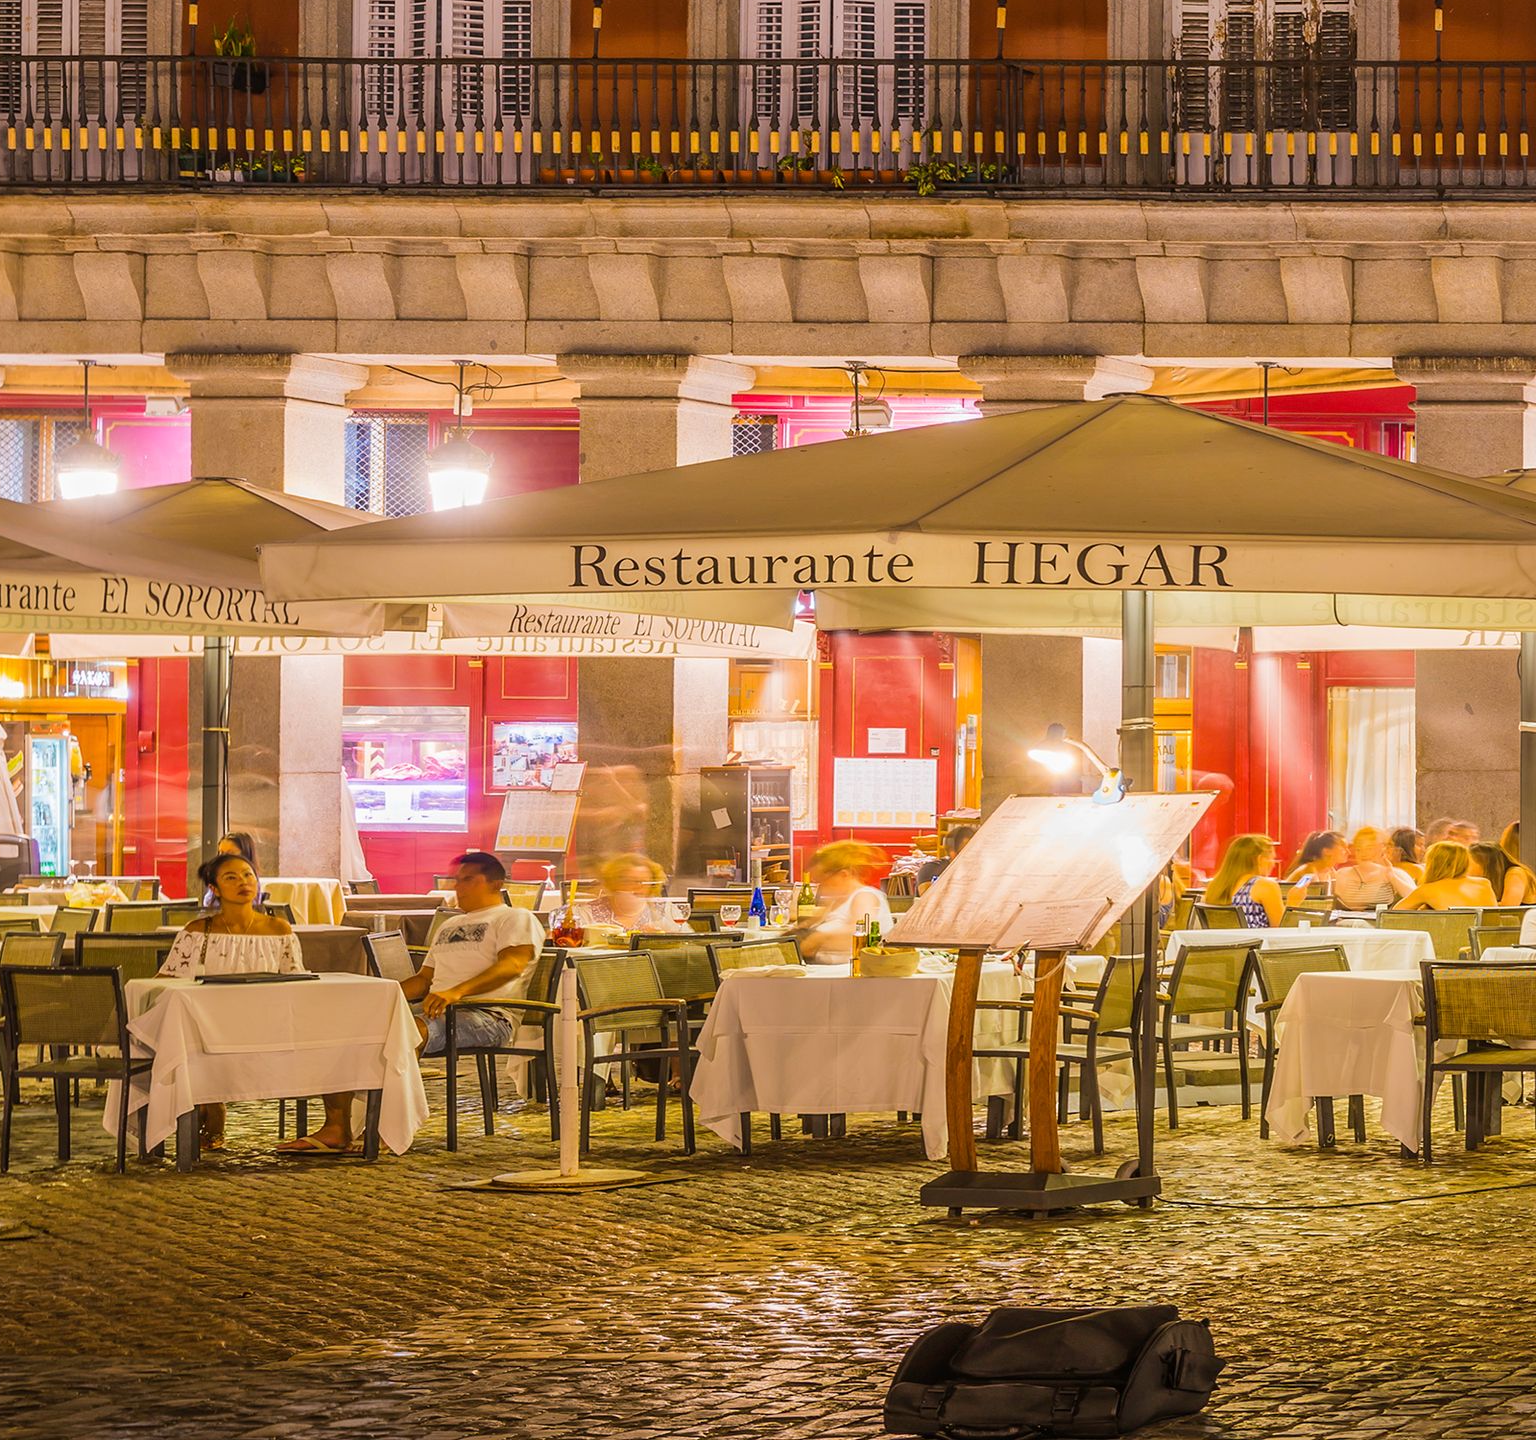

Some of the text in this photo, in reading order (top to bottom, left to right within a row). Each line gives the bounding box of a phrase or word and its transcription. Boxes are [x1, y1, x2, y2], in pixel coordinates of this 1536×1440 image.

[568, 542, 1234, 589] Restaurante HEGAR
[100, 576, 129, 615] El
[145, 580, 300, 625] SOPORTAL
[507, 604, 761, 649] Restaurante El SOPORTAL
